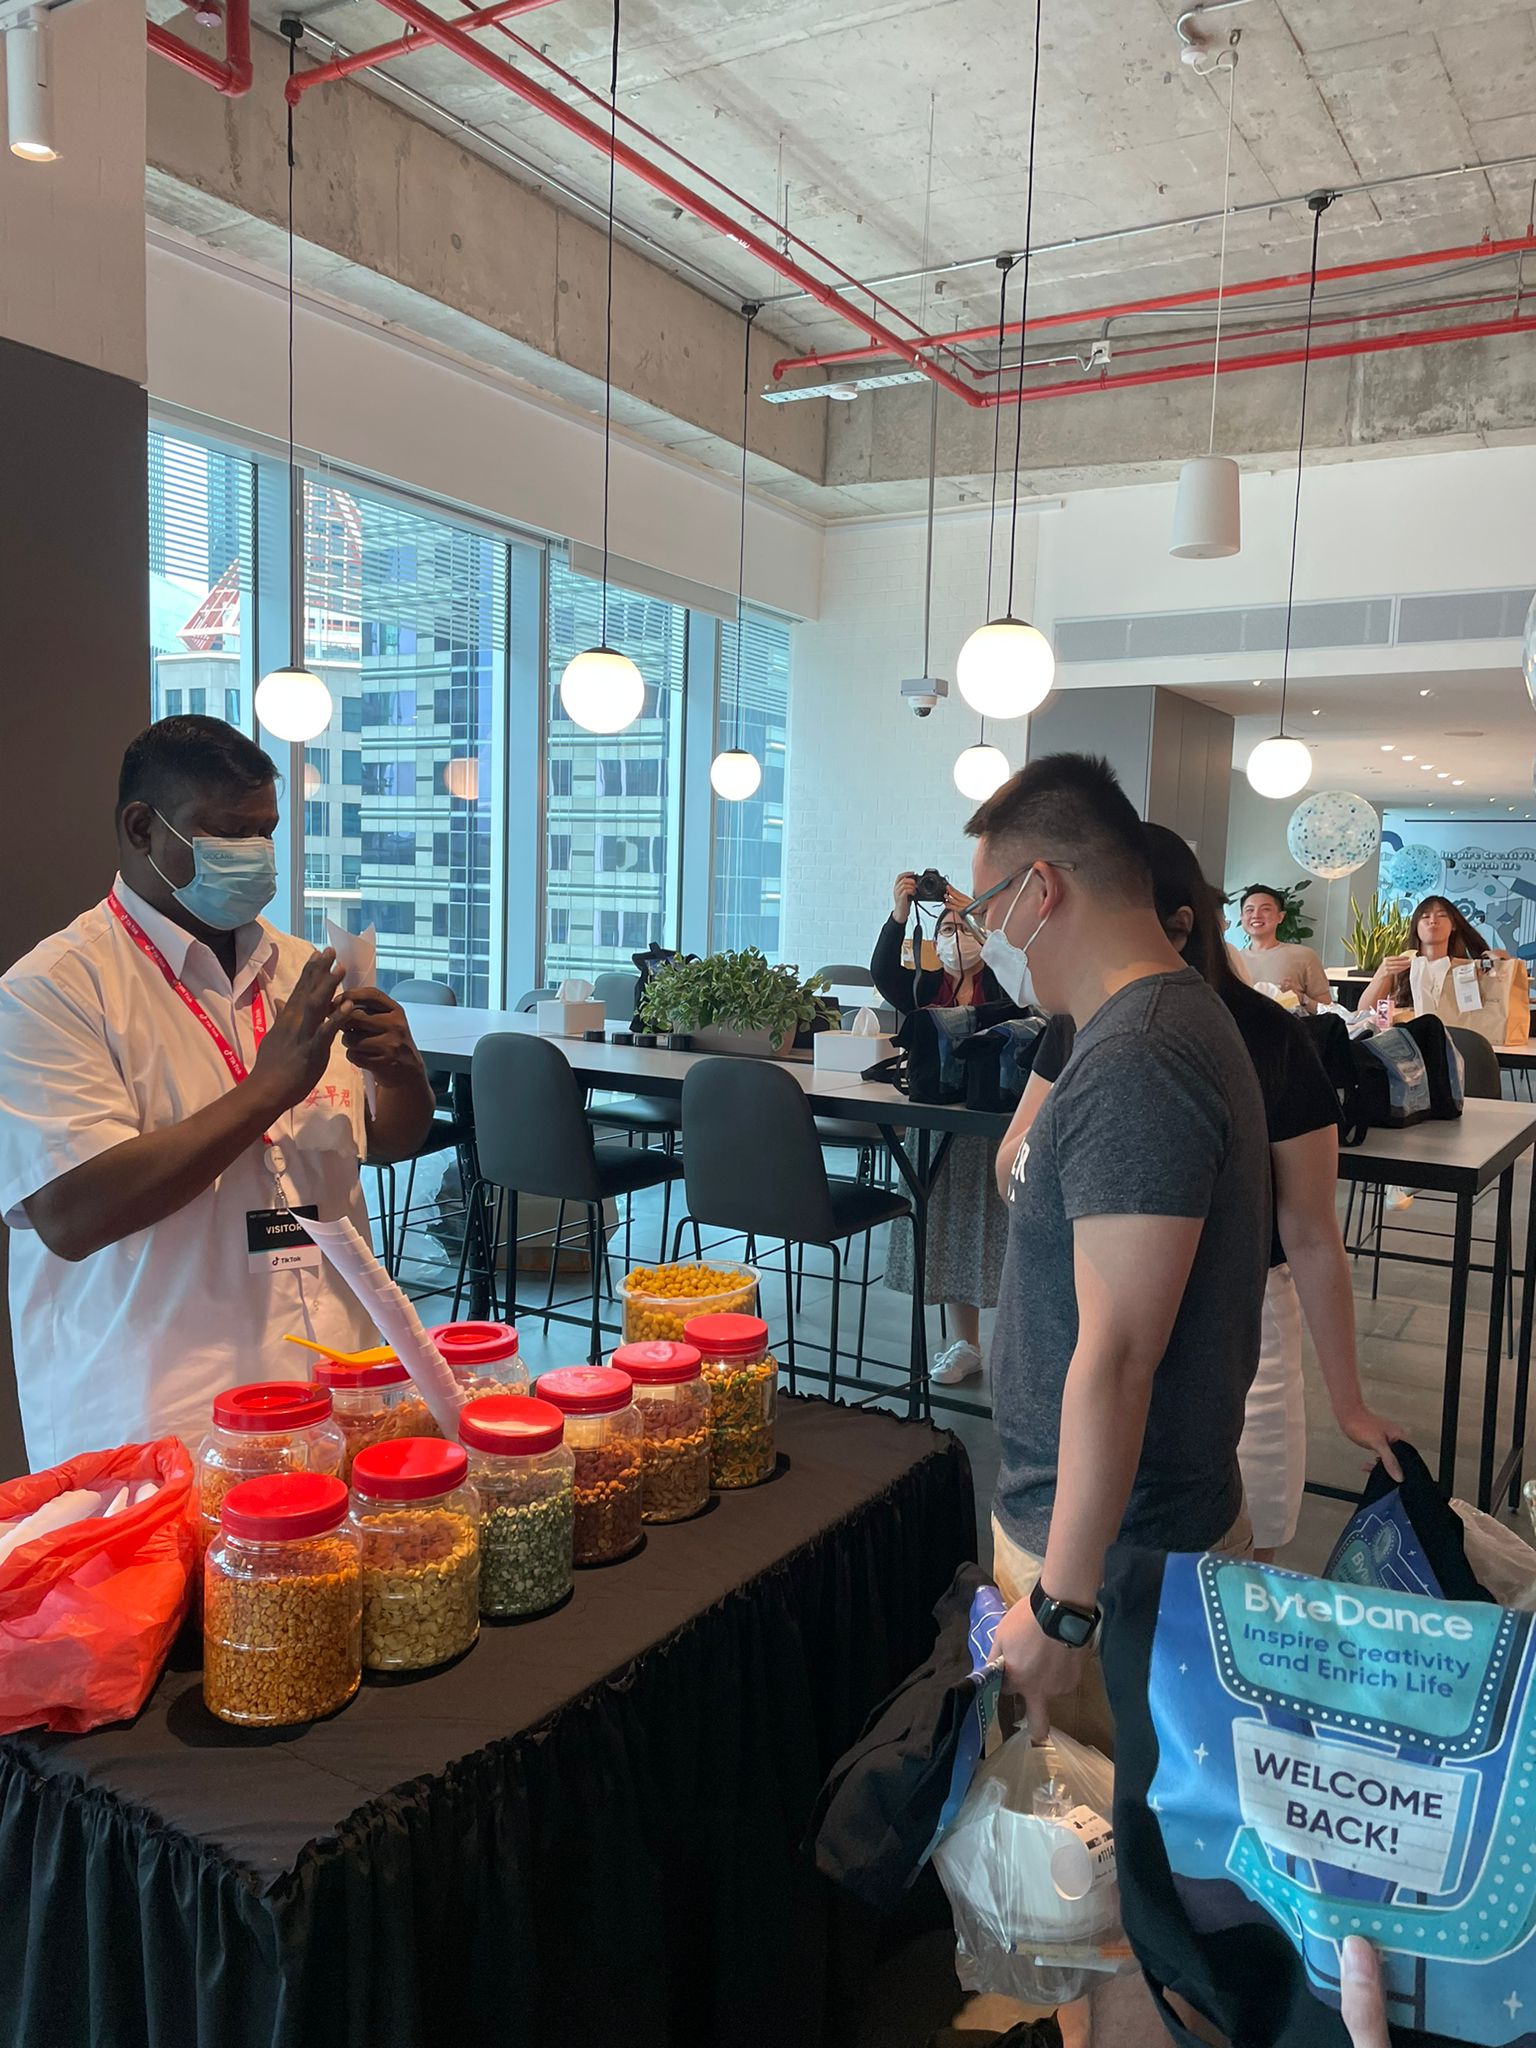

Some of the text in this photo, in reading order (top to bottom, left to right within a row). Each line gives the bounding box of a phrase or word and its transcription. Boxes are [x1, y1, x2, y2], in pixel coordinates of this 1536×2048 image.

[1483, 851, 1536, 862] Creativit
[266, 1223, 302, 1235] VISITOR
[281, 1256, 301, 1264] TikTok
[1243, 1582, 1474, 1641] ByteDance
[1243, 1623, 1471, 1679] Inspire Creativity
[1258, 1651, 1454, 1698] and Enrich Life
[1253, 1748, 1444, 1820] WELCOME
[1285, 1800, 1399, 1855] BACK!
